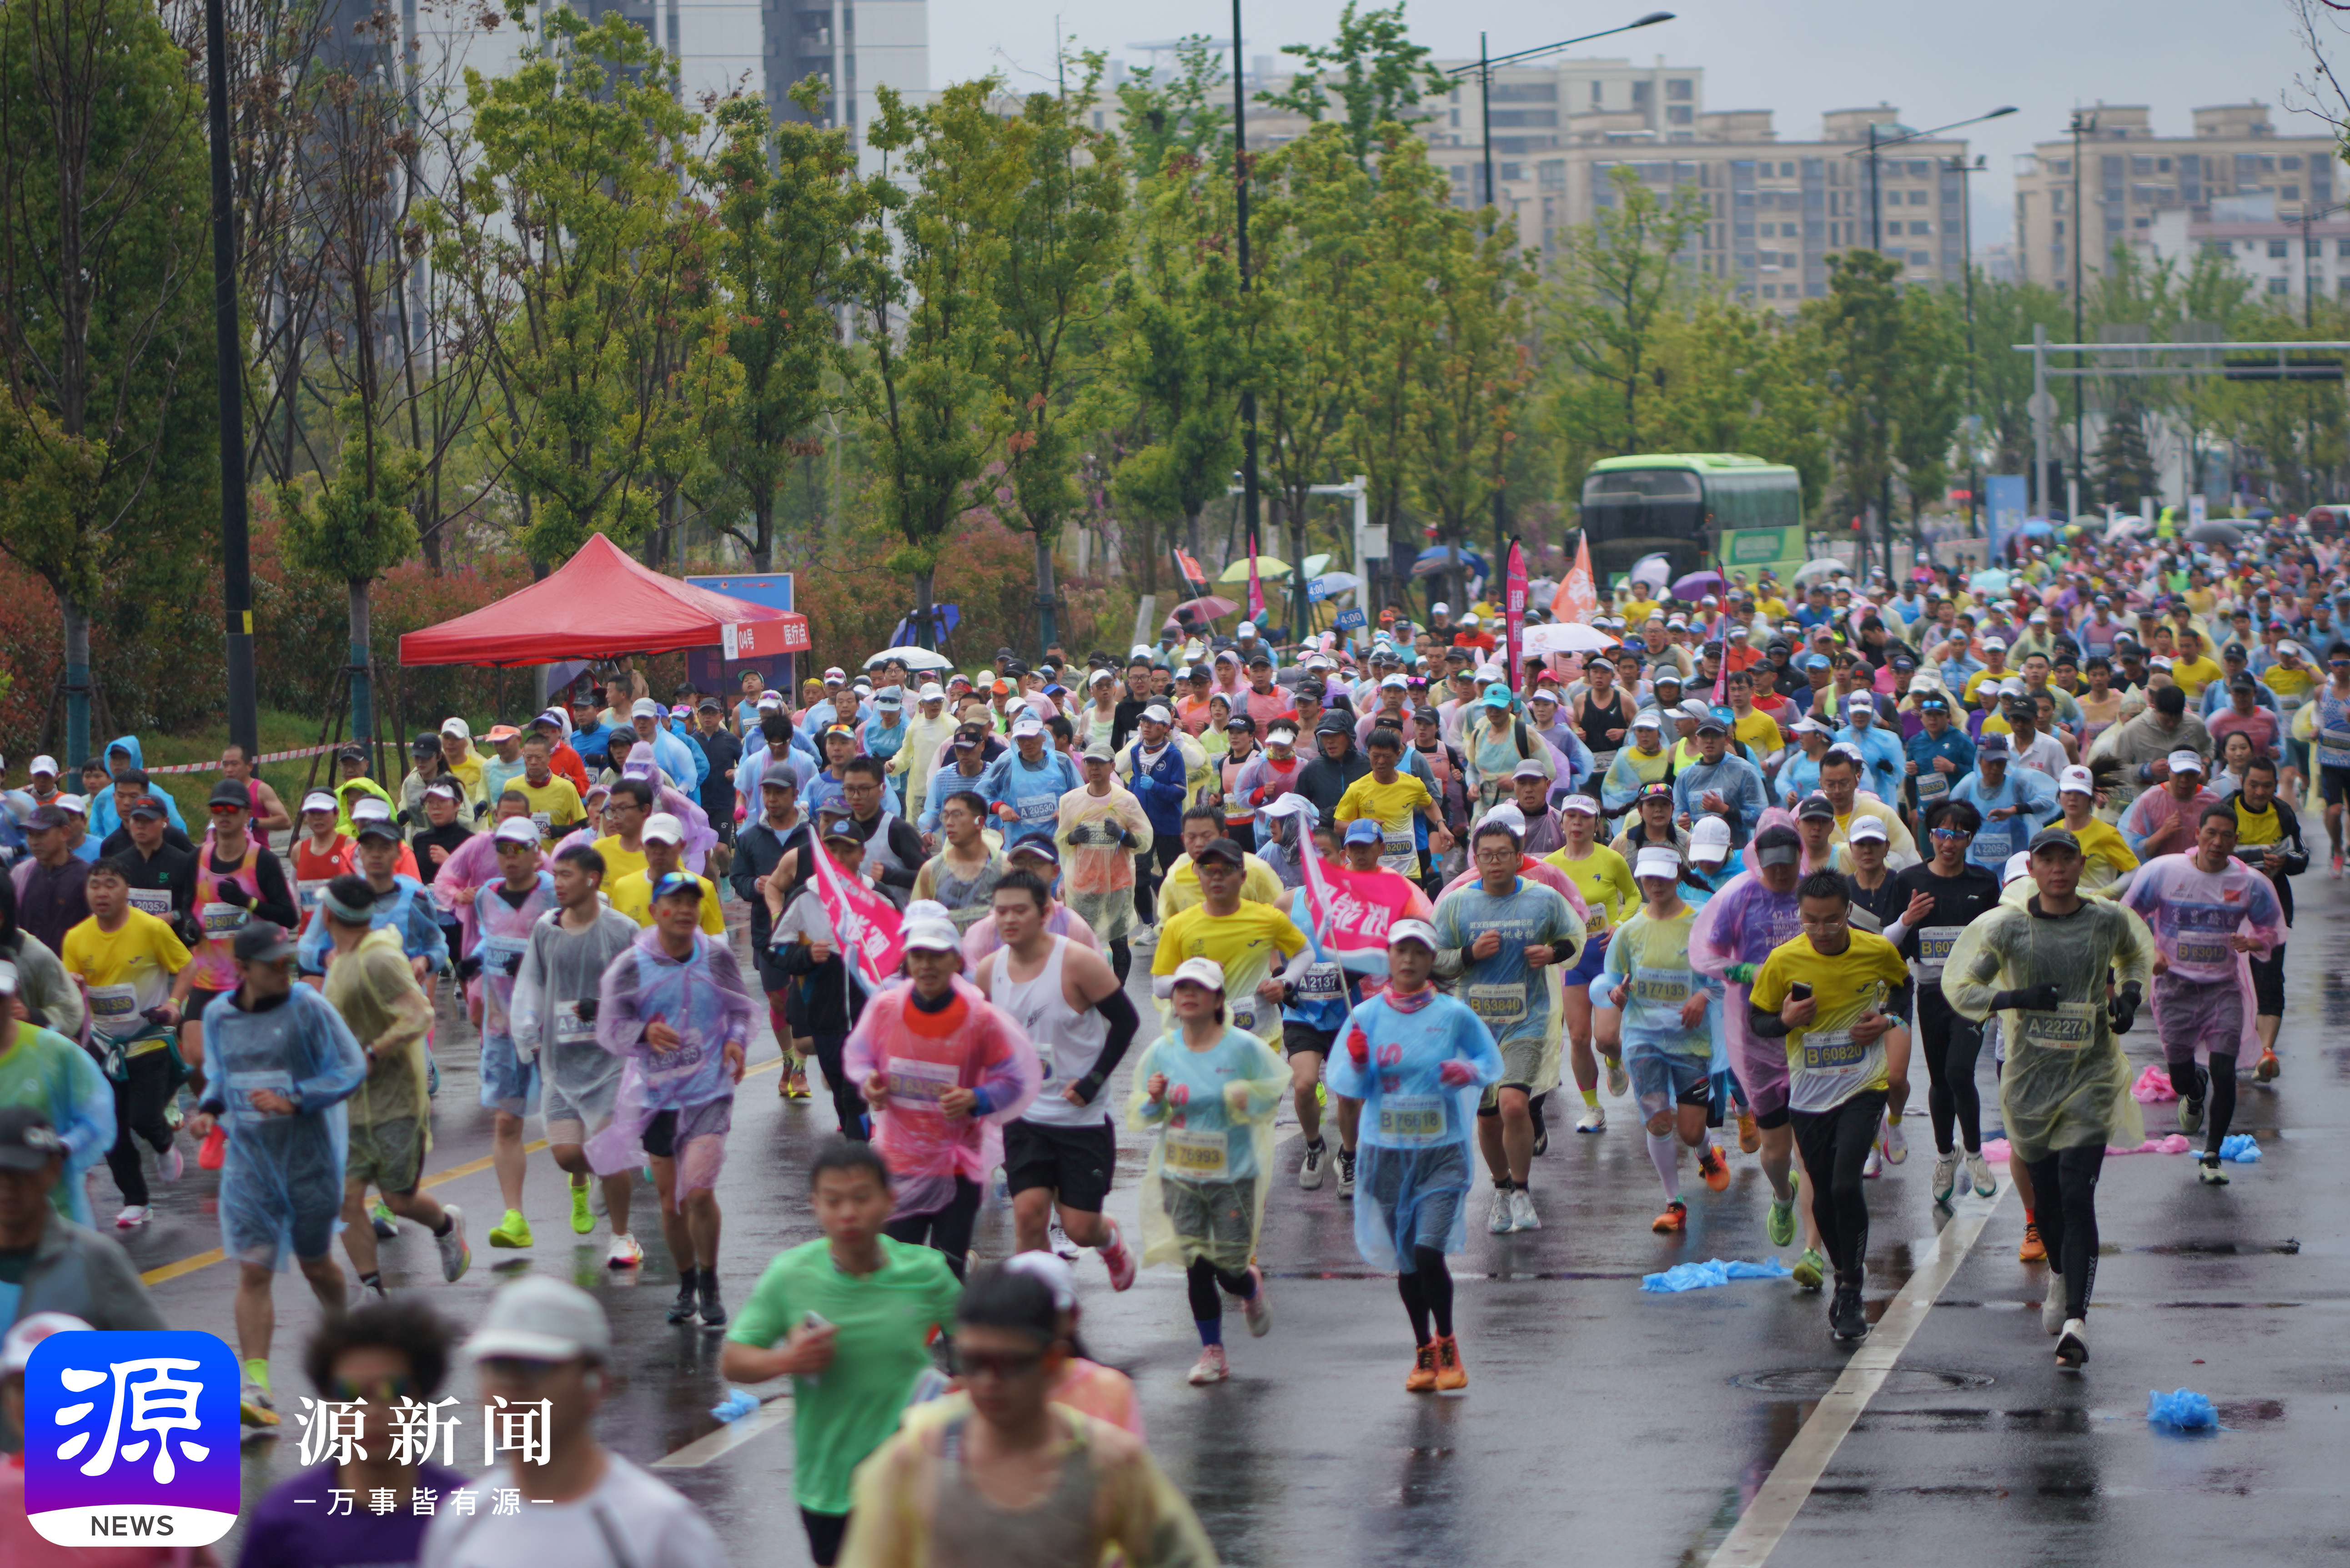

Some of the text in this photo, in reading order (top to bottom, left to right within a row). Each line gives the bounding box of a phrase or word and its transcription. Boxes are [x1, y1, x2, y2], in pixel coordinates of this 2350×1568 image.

[1310, 583, 1324, 596] 4:00
[1341, 612, 1362, 624] 4:00
[783, 622, 808, 645] 医疗点
[1021, 802, 1054, 817] A 20530
[1386, 841, 1411, 851] 62070
[137, 901, 166, 912] 20352
[1921, 941, 1932, 955] B
[1299, 976, 1308, 989] A
[1649, 982, 1685, 996] 77133
[1471, 999, 1521, 1011] B 63840
[2028, 1018, 2088, 1035] A 22274
[1807, 1045, 1863, 1064] B 60820
[1381, 1112, 1392, 1128] B
[1180, 1147, 1221, 1164] 76993
